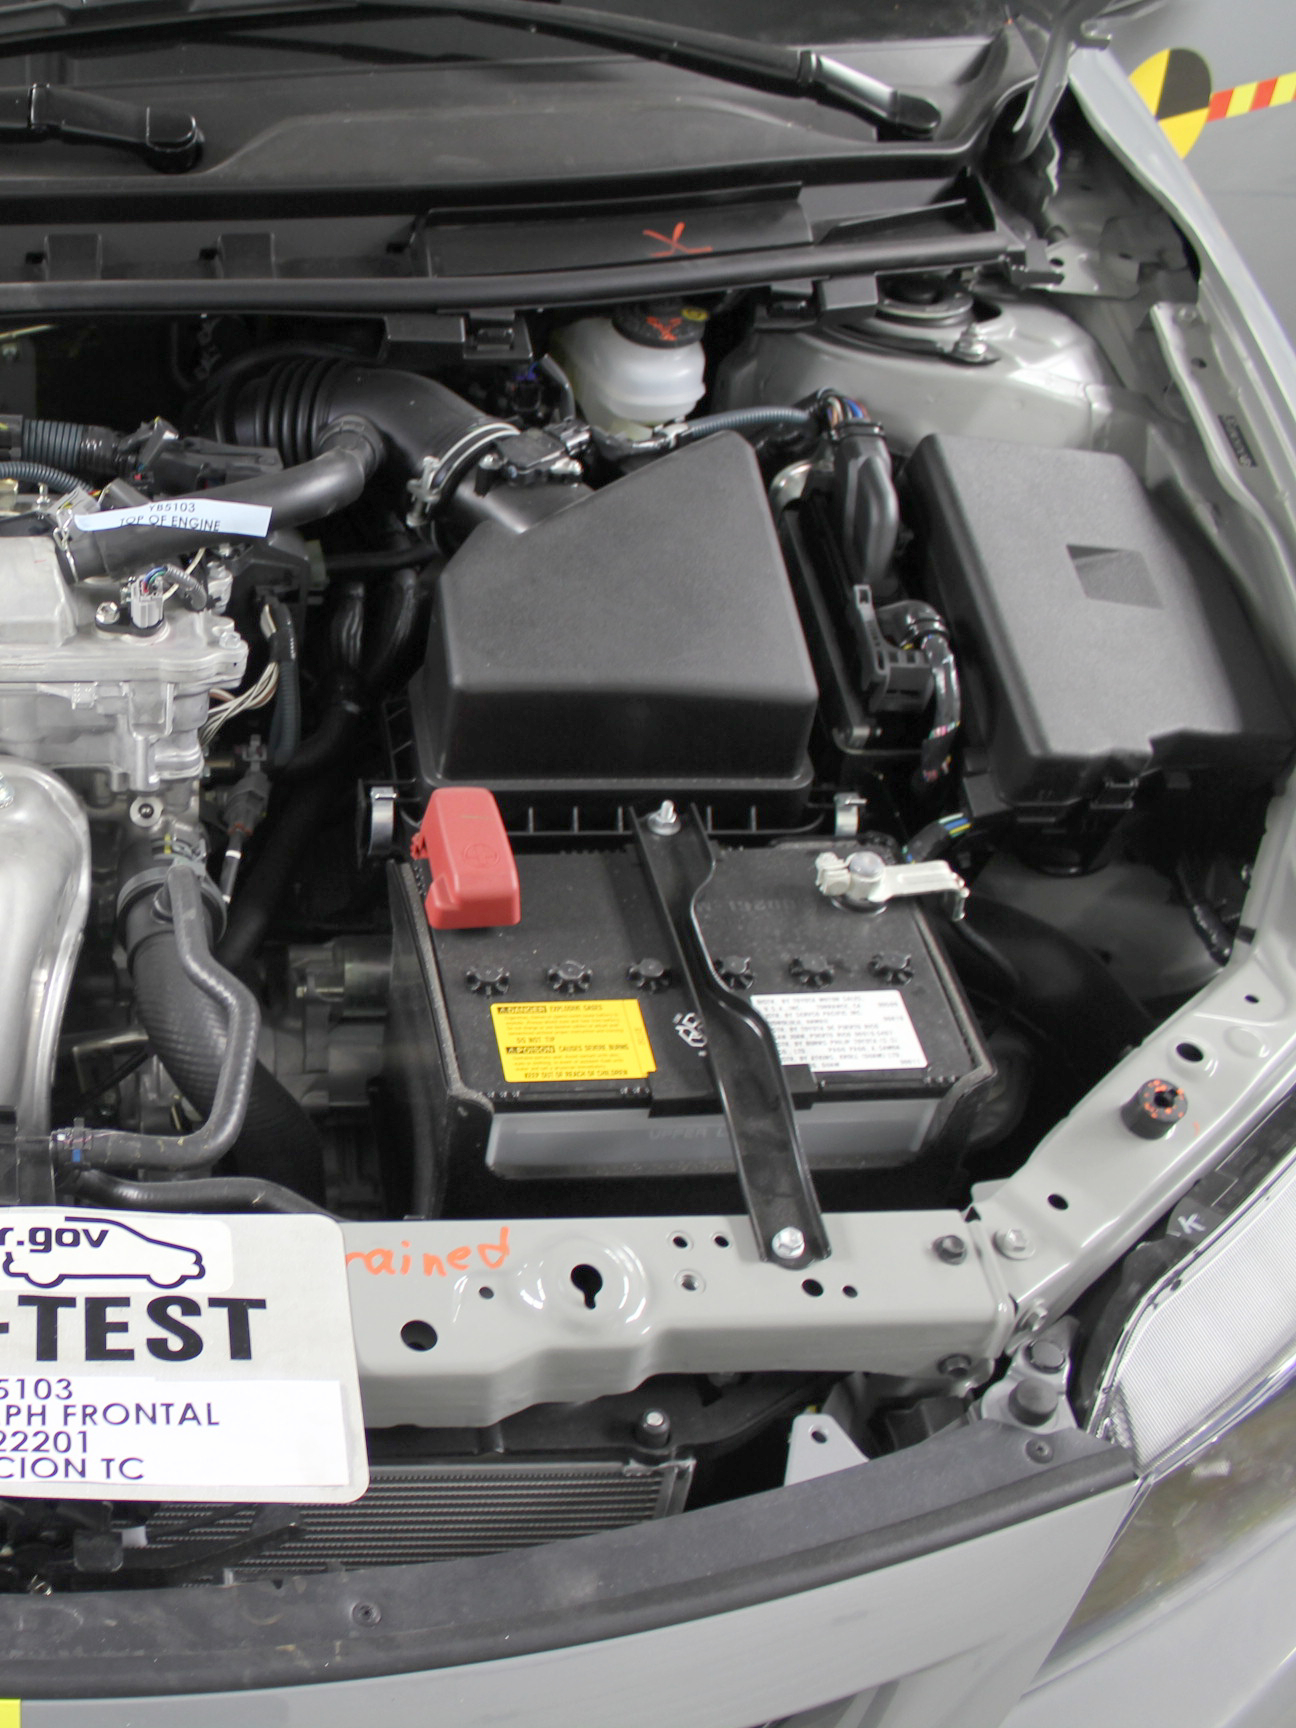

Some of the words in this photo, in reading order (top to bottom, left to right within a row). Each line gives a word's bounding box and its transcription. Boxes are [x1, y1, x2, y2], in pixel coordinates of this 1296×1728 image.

[149, 502, 196, 512] YB5103
[120, 515, 145, 526] TOP
[148, 514, 168, 526] OF
[171, 516, 221, 532] ENGINE
[63, 1402, 220, 1426] FRONTAL
[101, 1457, 144, 1480] TC
